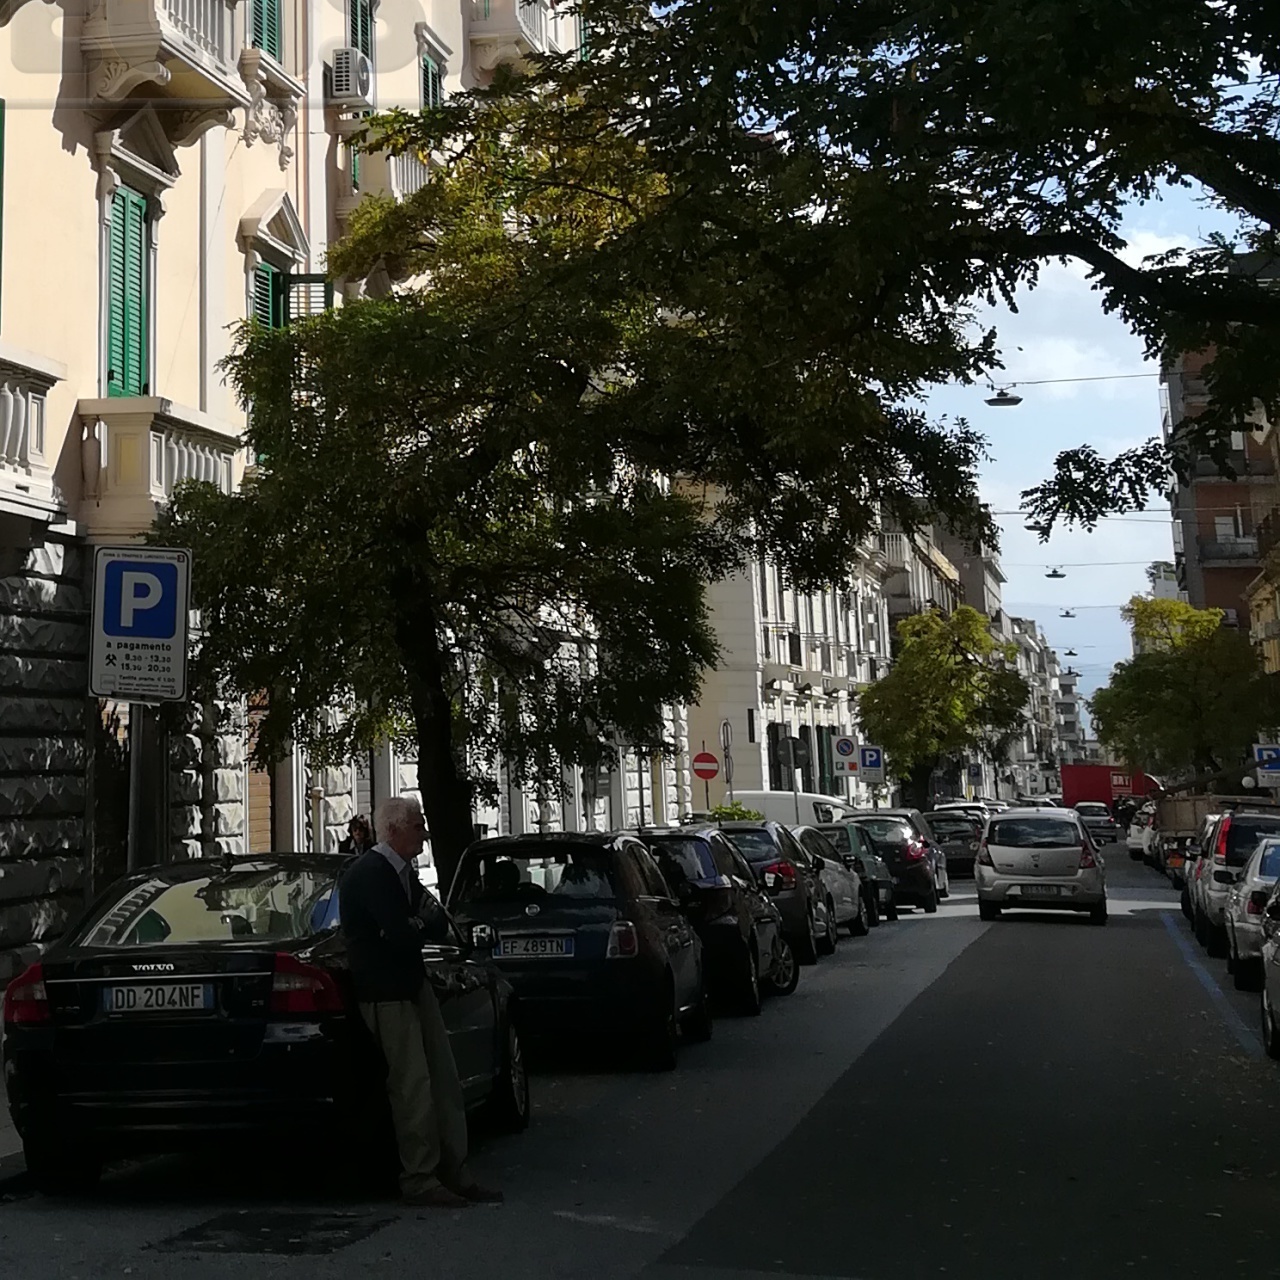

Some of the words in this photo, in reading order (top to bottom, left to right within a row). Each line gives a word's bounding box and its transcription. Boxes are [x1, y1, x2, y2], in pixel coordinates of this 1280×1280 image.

[120, 571, 163, 627] P
[106, 641, 112, 649] a
[117, 642, 172, 651] pagamento
[865, 750, 877, 766] P
[502, 941, 517, 954] EF
[523, 939, 564, 953] 489TN
[132, 963, 175, 971] VOLVO
[114, 988, 137, 1010] DD
[143, 986, 202, 1008] 204NF
